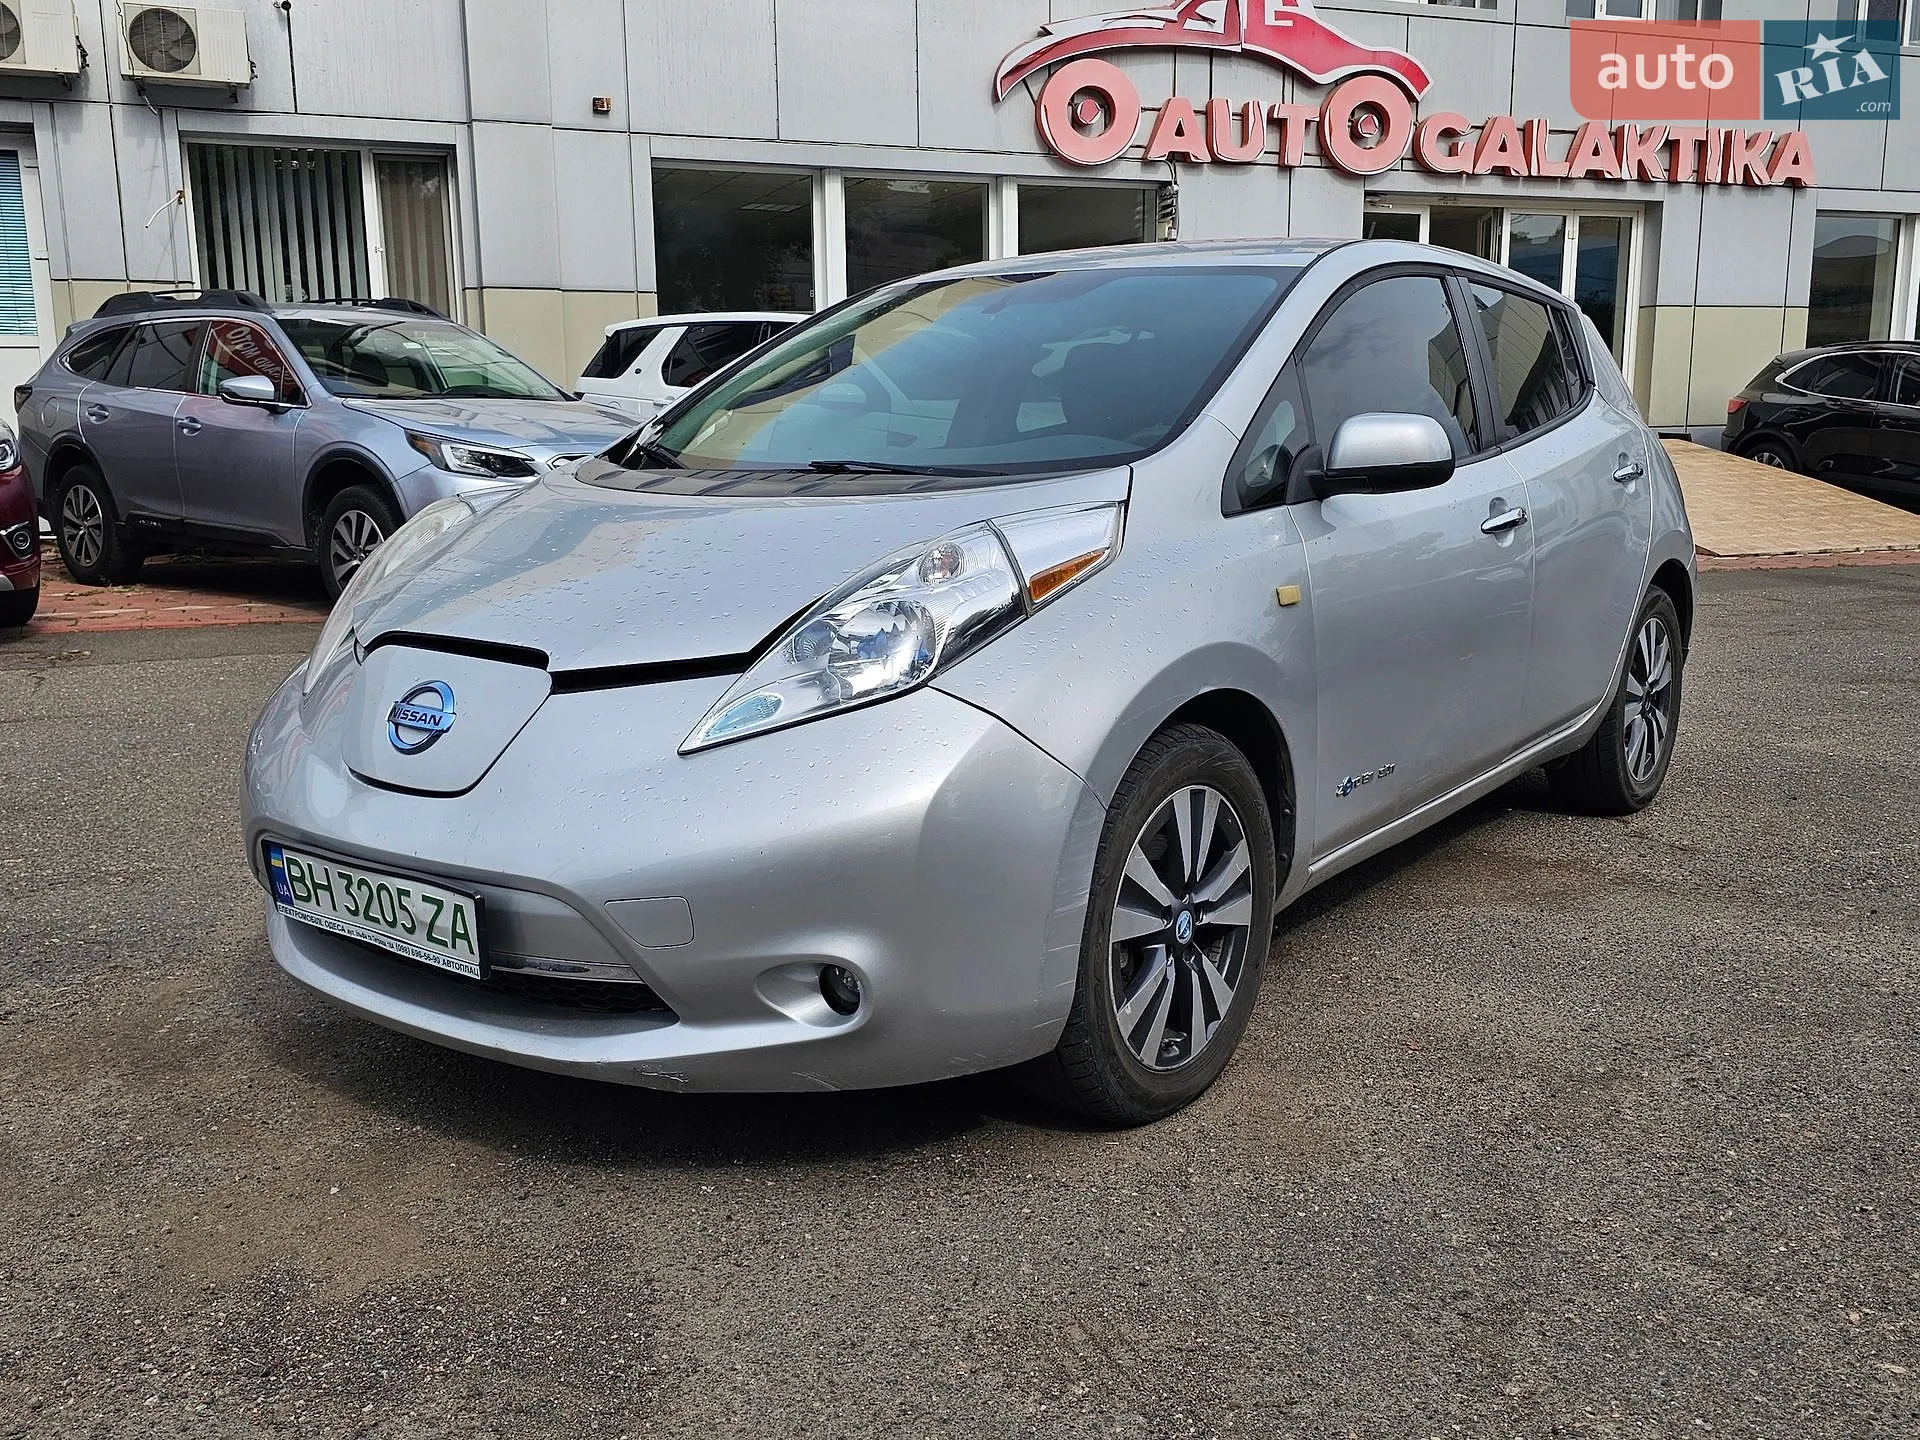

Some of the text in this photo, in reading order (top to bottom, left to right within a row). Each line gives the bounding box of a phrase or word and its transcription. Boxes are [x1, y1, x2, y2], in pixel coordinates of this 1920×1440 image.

[392, 707, 443, 727] NISSAN
[276, 881, 291, 898] UA
[285, 855, 475, 955] BH 3205 ZA
